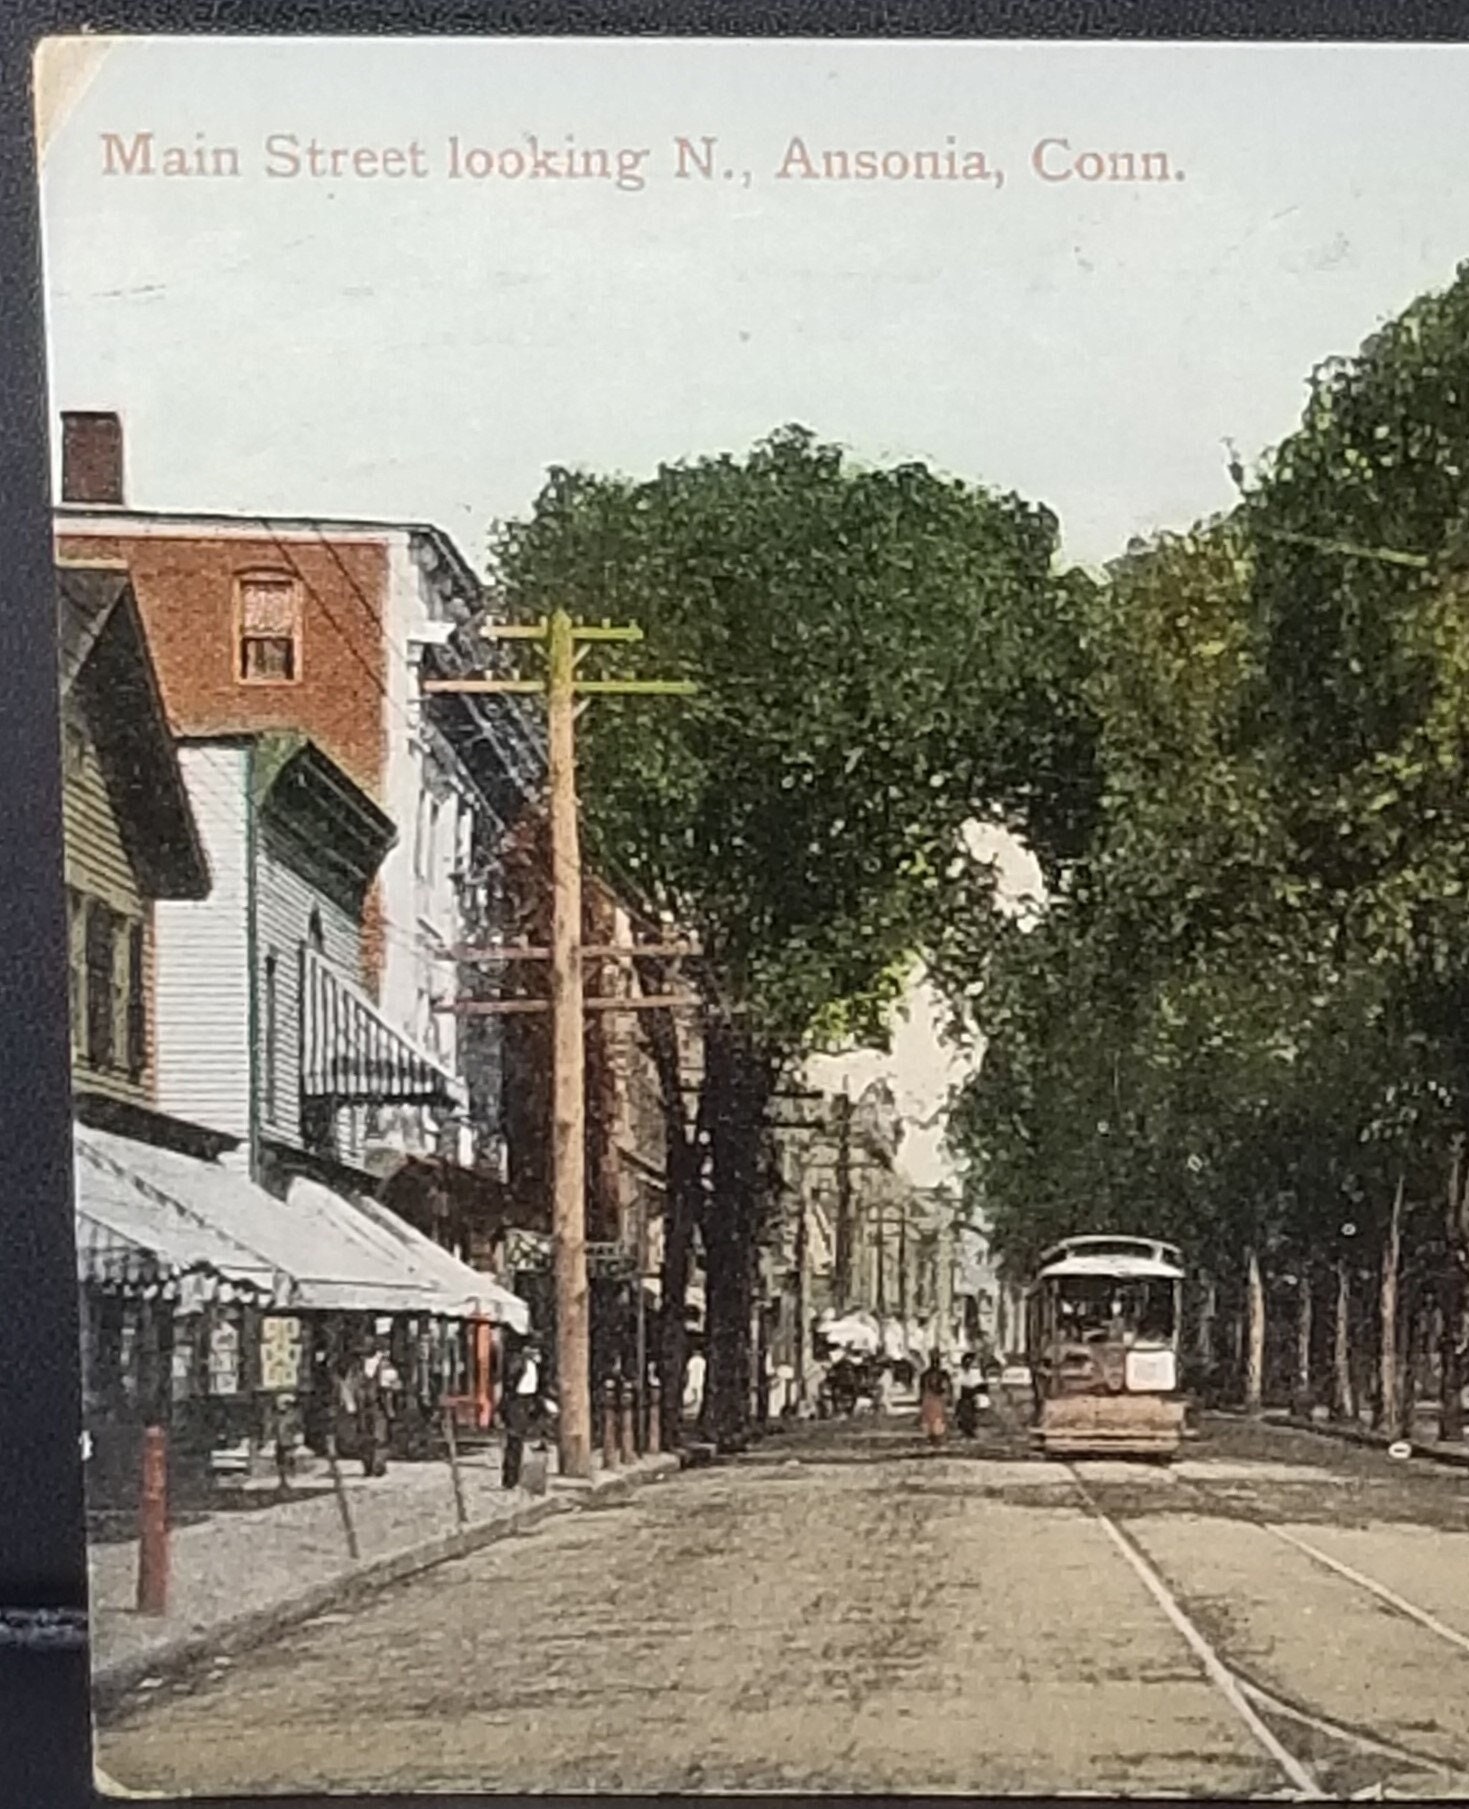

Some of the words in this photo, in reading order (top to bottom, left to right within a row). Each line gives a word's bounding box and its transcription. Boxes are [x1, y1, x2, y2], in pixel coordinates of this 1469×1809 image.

[99, 131, 240, 177] Main
[264, 133, 429, 179] Street
[448, 133, 651, 192] looking
[674, 135, 752, 190] N.,
[774, 135, 1004, 190] Ansonia,
[1031, 137, 1186, 183] Conn.
